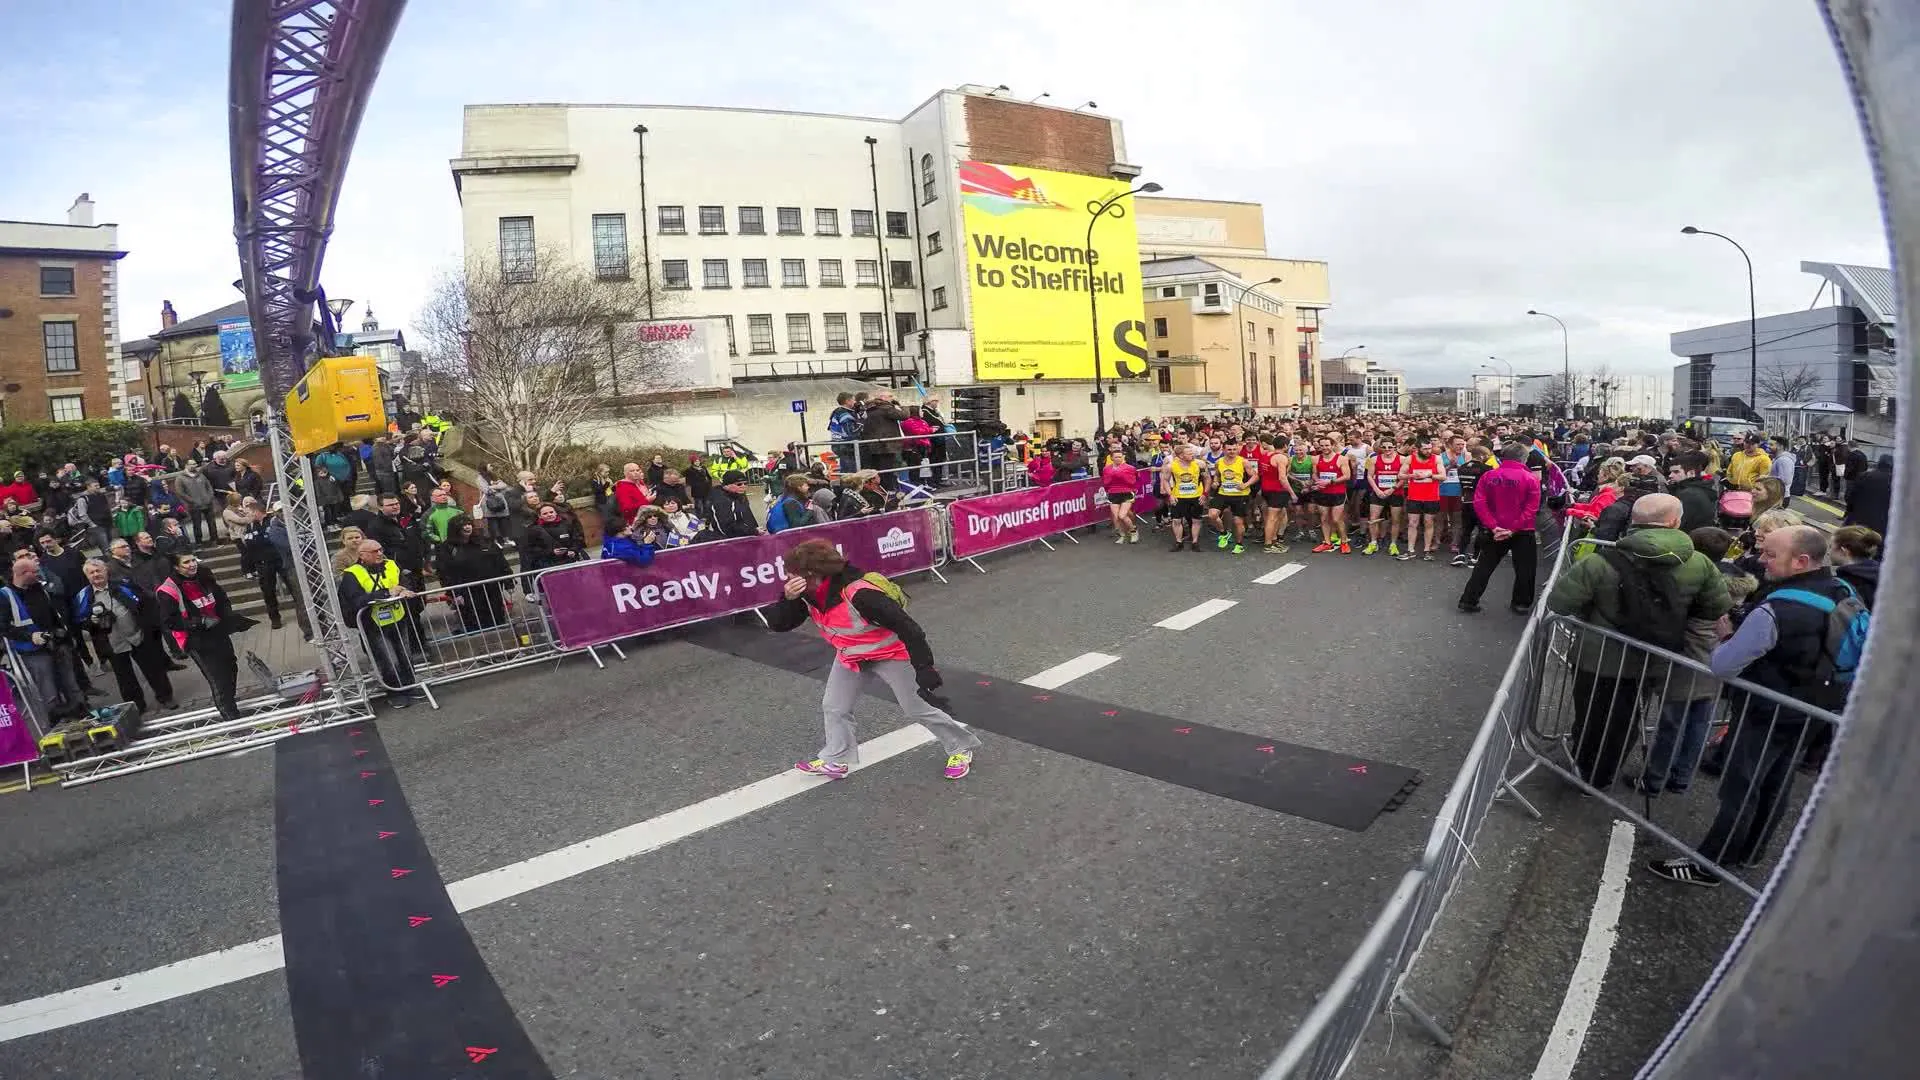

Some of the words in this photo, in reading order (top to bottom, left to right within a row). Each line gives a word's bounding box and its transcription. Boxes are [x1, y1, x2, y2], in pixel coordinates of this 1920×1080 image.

[972, 233, 1099, 266] Welcome
[976, 263, 1005, 288] to
[1010, 264, 1124, 294] Sheffield
[639, 323, 696, 334] CENTRAL
[640, 332, 692, 343] LIBRARY
[967, 513, 990, 536] Do
[992, 500, 1050, 537] yourself
[1052, 492, 1087, 520] proud
[882, 538, 911, 551] plusnet
[611, 571, 732, 613] Ready,
